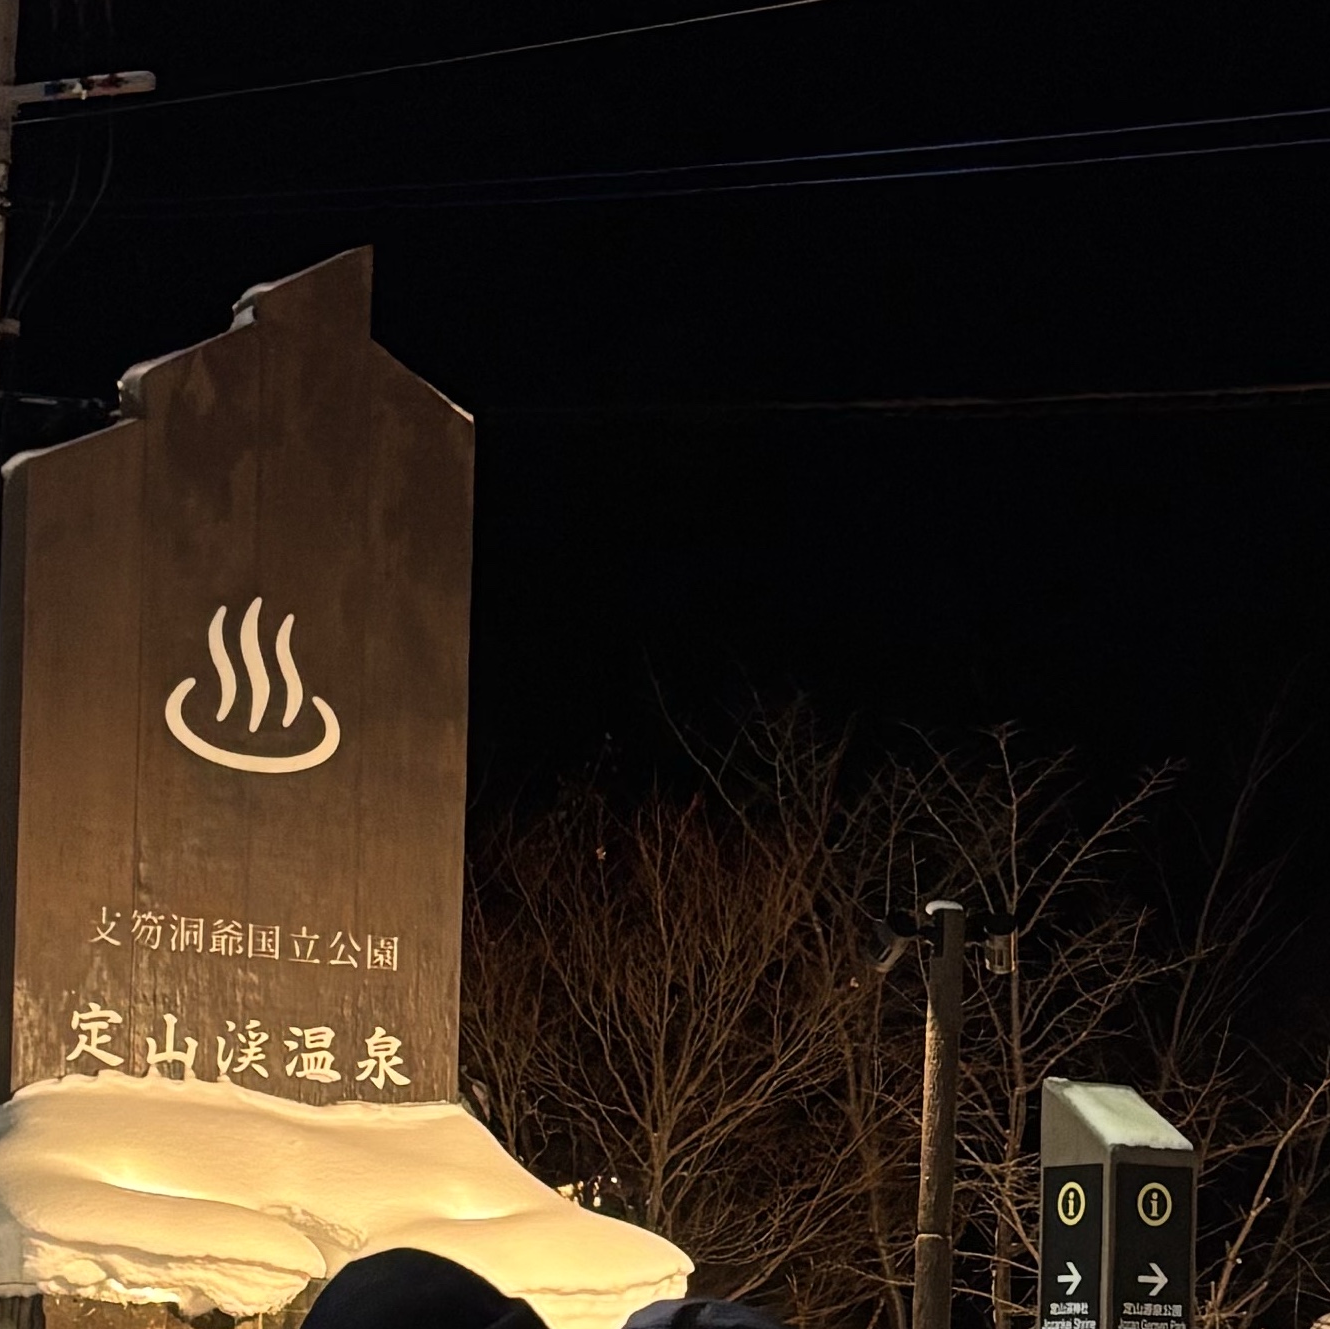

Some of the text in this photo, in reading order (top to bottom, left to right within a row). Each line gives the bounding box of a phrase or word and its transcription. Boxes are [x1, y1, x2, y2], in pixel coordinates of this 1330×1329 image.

[66, 1003, 412, 1090] 定山渓温泉
